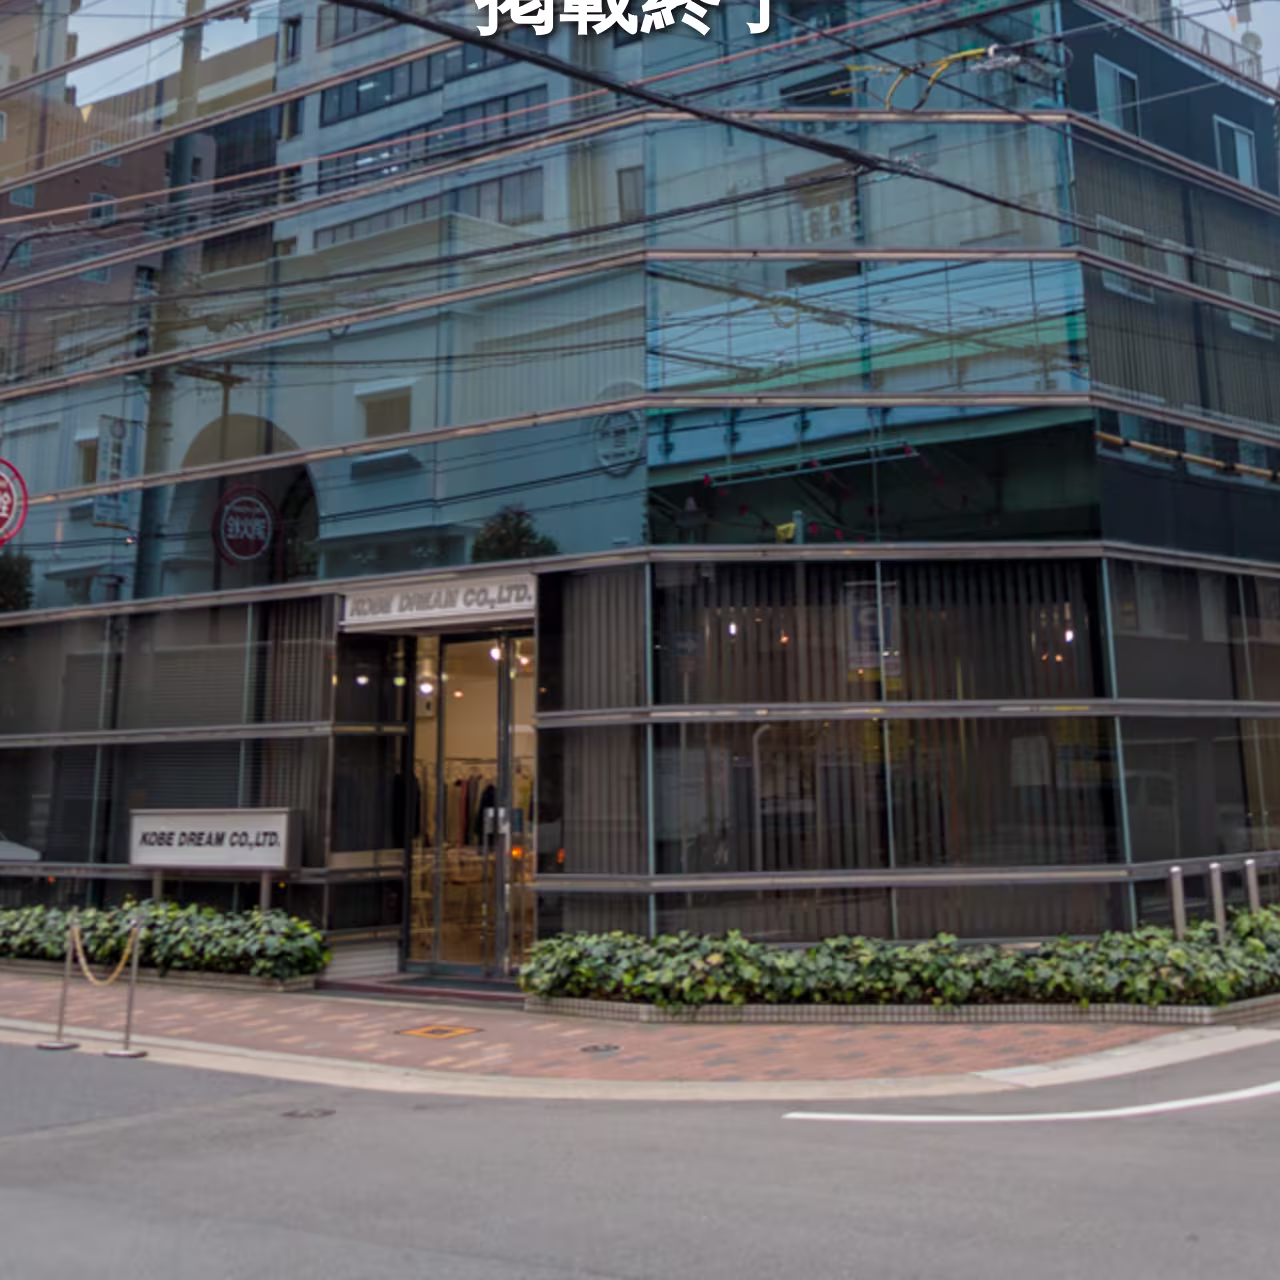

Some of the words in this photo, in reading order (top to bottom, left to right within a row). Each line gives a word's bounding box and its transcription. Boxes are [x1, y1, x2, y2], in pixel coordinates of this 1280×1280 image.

[398, 587, 459, 612] DREAM
[139, 830, 174, 847] KOBE
[178, 830, 226, 847] DREAM
